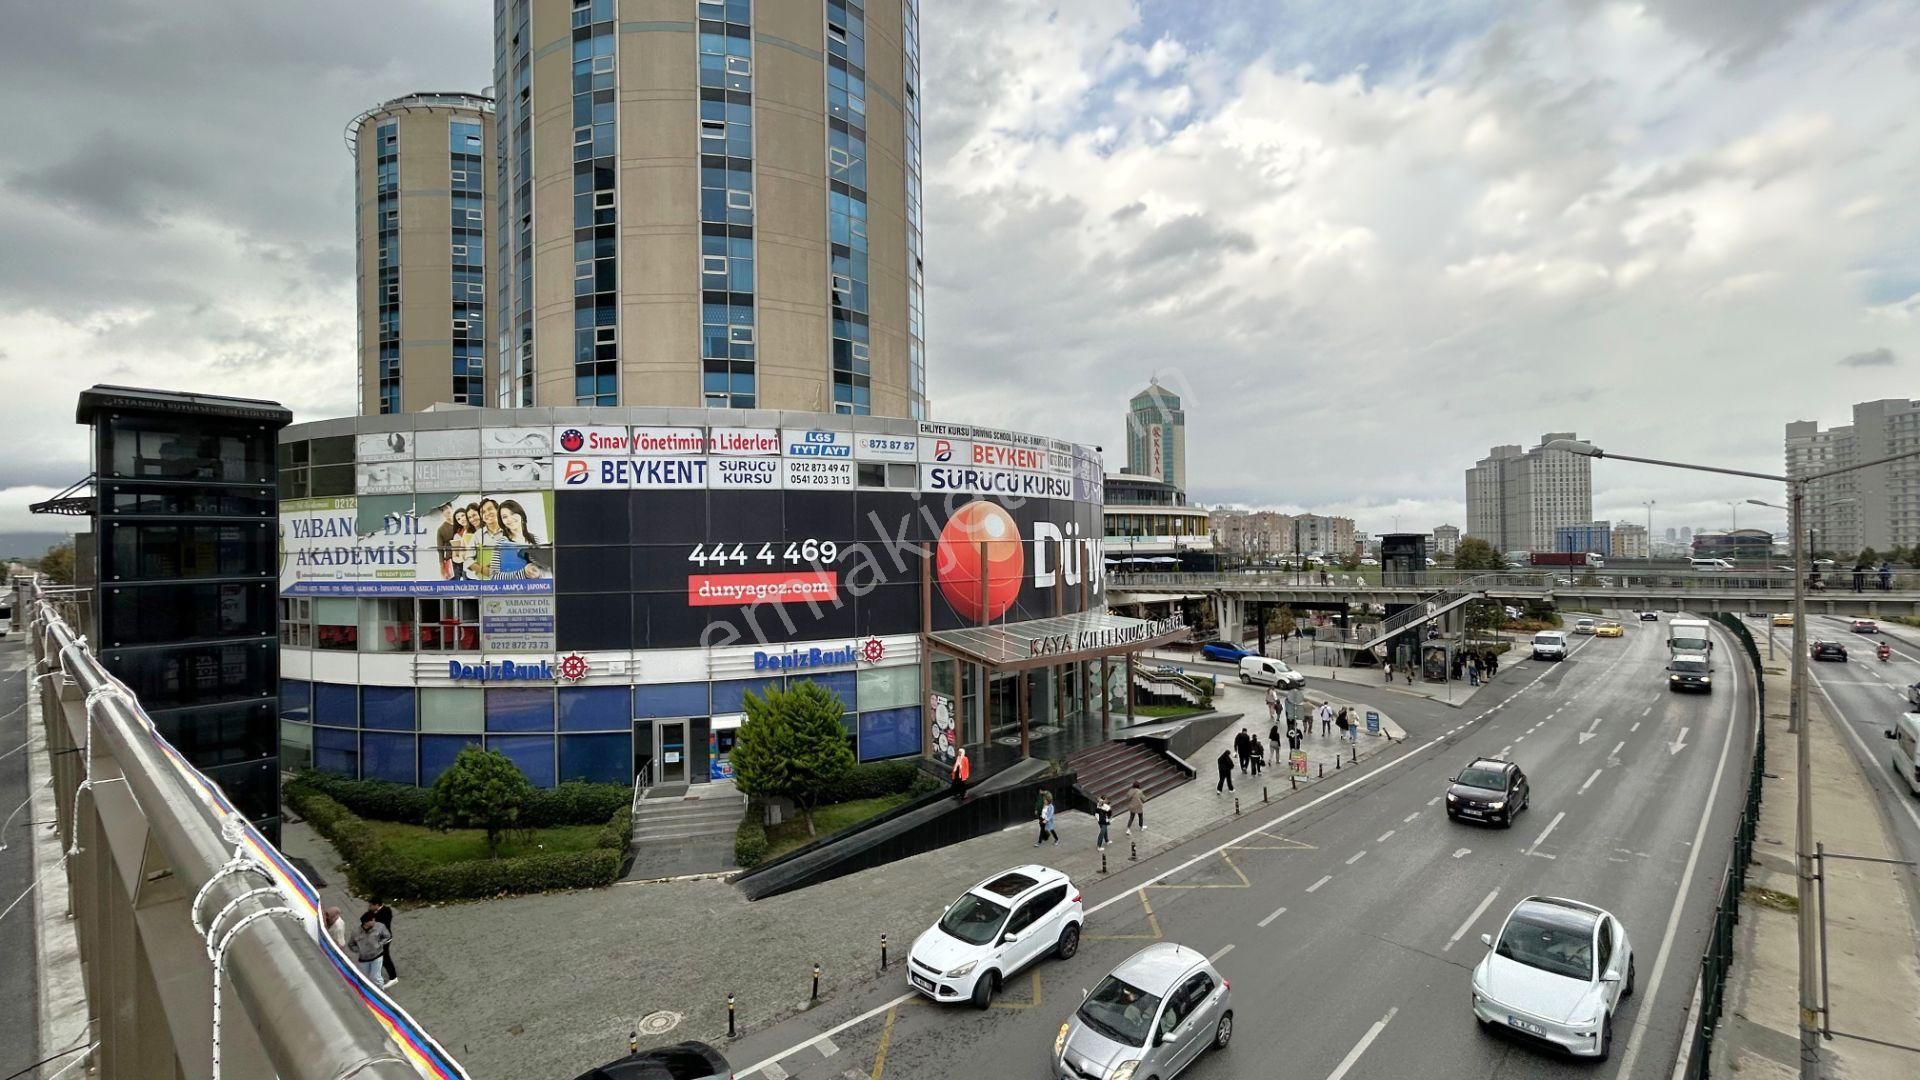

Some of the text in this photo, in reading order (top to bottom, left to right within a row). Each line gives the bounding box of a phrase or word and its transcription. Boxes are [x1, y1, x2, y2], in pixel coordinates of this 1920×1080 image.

[809, 433, 831, 441] LGS
[920, 423, 970, 437] EHLİYET KURSU
[993, 431, 1012, 442] SCHOOL
[589, 432, 629, 449] Sınav
[720, 433, 779, 450] Liderleri
[869, 439, 915, 450] 873 87 87
[793, 445, 847, 456] TYT AYT
[973, 444, 1046, 469] BEYKENT
[1153, 438, 1161, 474] KAYA
[601, 460, 707, 484] BEYKENT
[719, 461, 776, 471] SÜRÜCÜ
[790, 463, 850, 473] 0212 873 49 47
[723, 473, 772, 484] KURSU
[790, 475, 850, 485] 0541 203 31 13
[930, 468, 1071, 497] SÜRÜCÜ KURSU
[296, 541, 418, 566] AKADEMİSİ
[688, 538, 837, 567] 444 4 469
[1033, 521, 1106, 596] Düny
[698, 580, 830, 599] dunyagoz.com
[491, 641, 550, 649] 0212 872 73 73
[1029, 633, 1074, 659] KAYA
[753, 645, 858, 671] DenizBank
[449, 660, 554, 681] DenizBank
